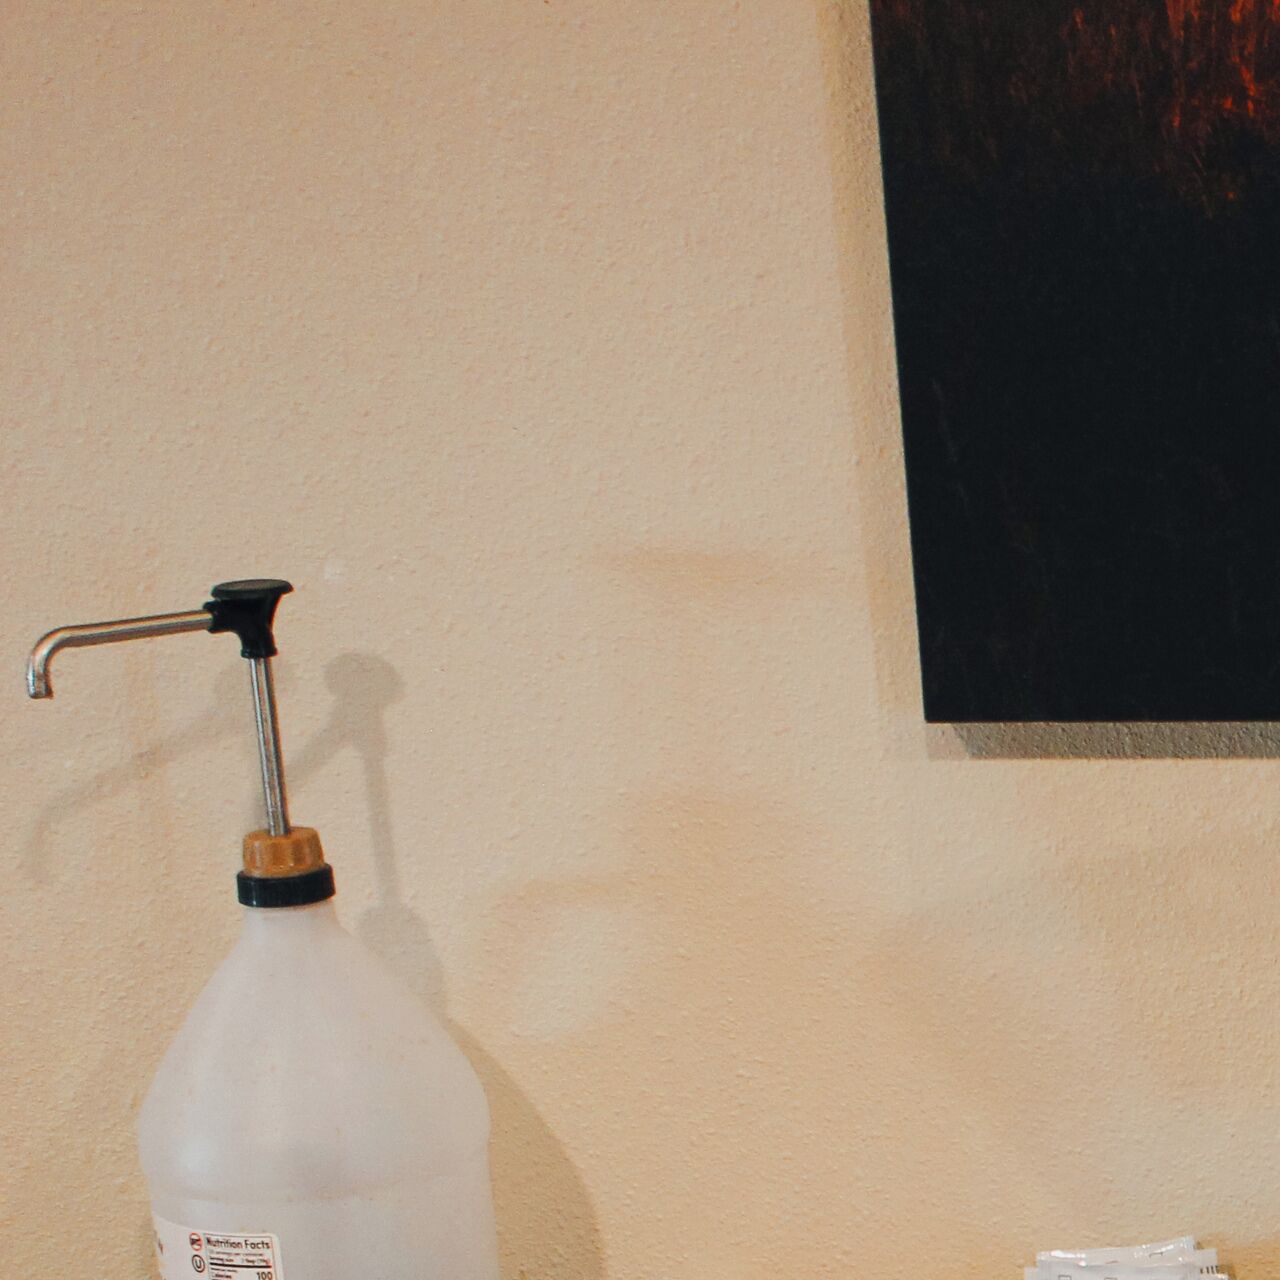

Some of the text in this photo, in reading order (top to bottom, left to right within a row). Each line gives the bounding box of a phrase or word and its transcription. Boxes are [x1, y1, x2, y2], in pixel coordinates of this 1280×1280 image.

[206, 1237, 270, 1249] Nutrition Facts
[256, 1271, 273, 1280] 100
